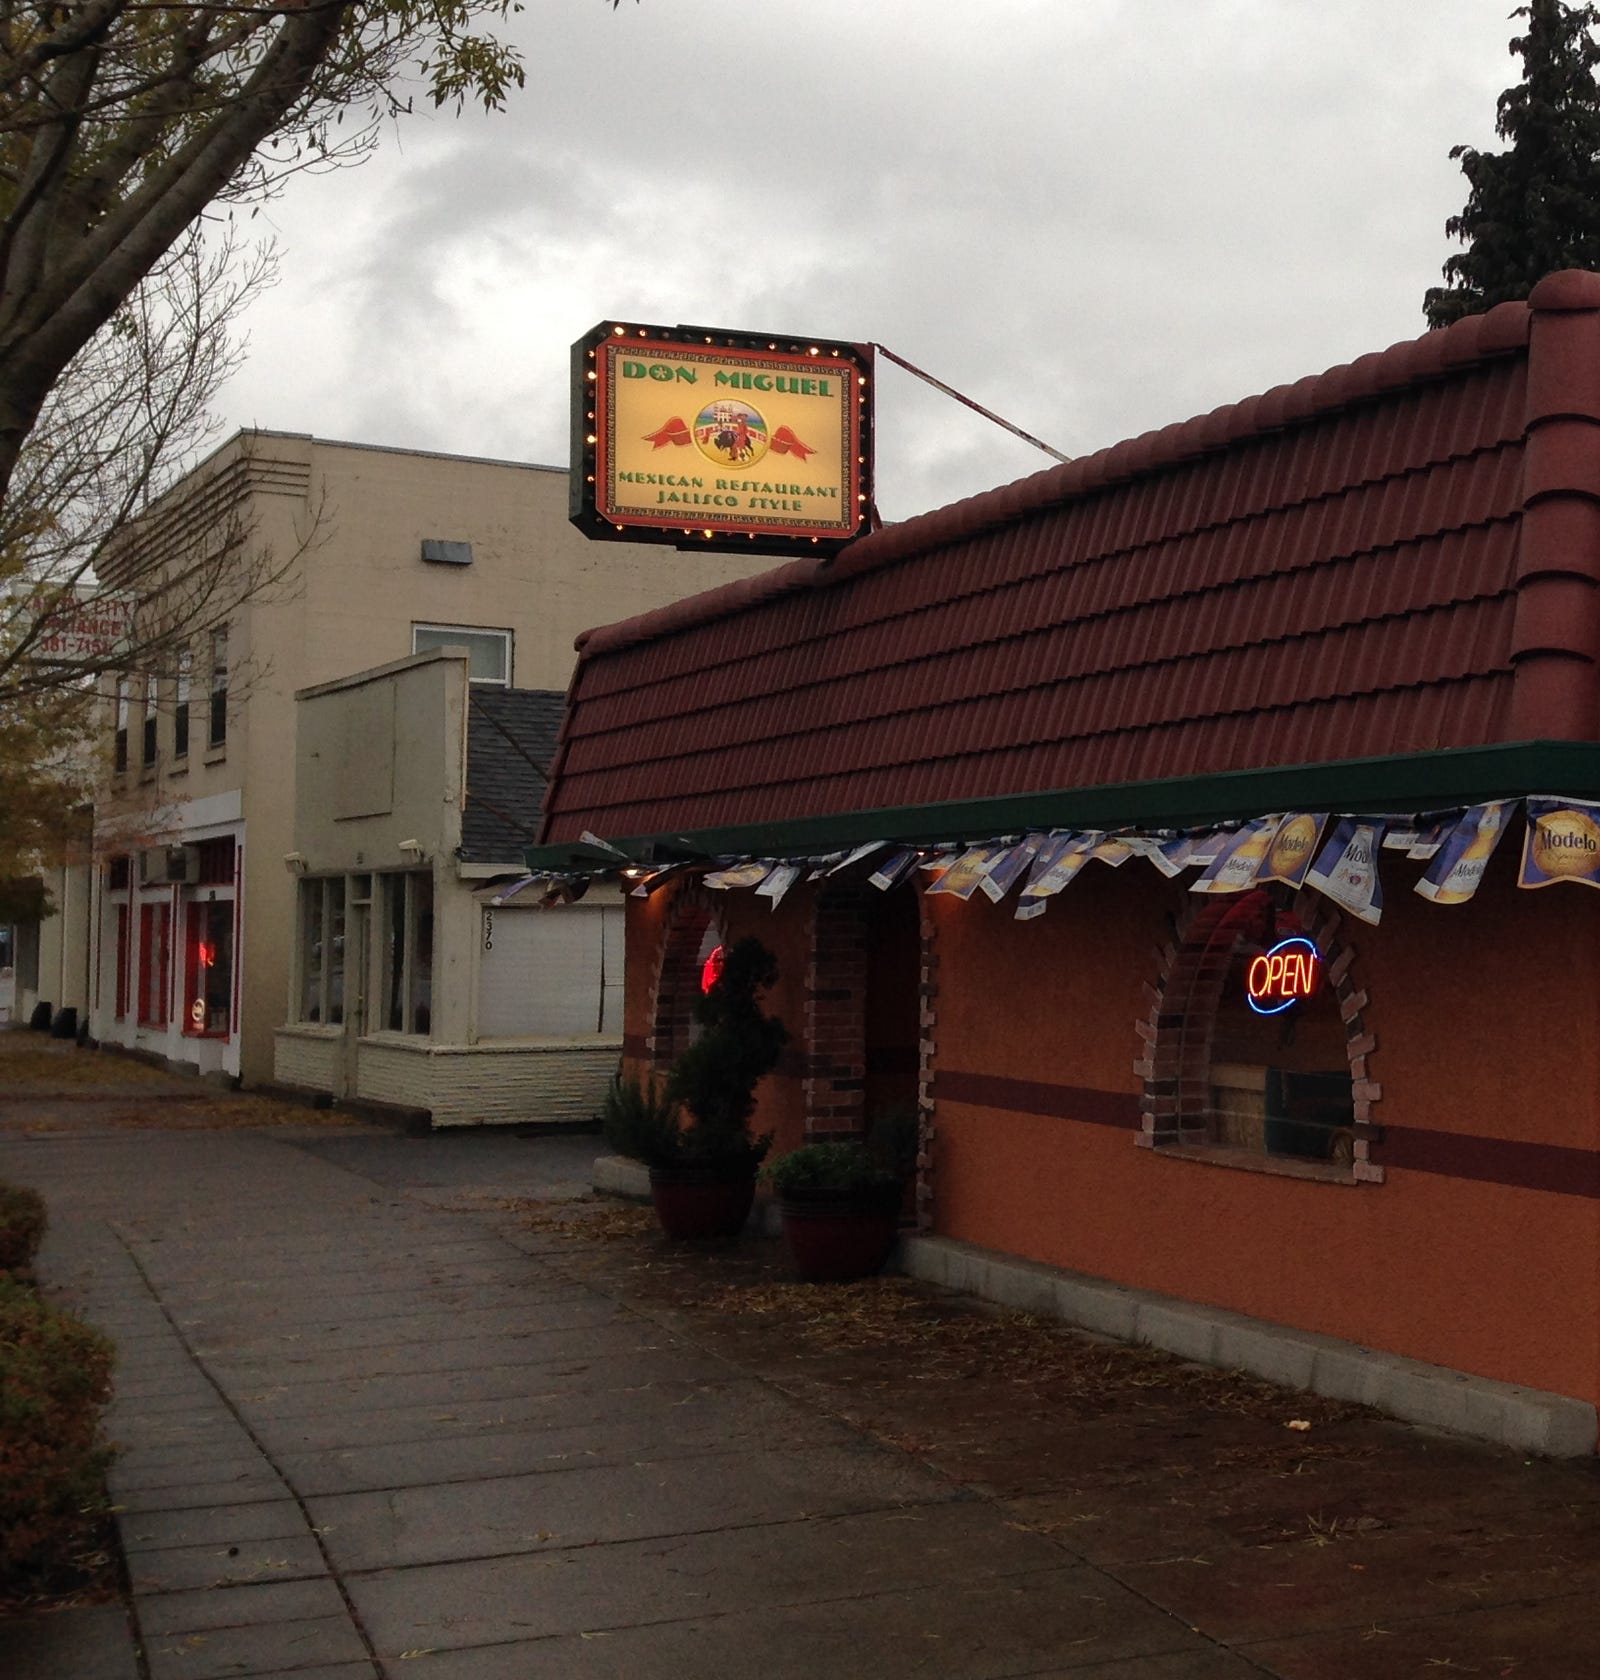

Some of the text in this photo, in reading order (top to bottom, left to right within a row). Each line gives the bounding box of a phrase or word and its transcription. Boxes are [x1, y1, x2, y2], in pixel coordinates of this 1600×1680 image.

[623, 361, 834, 397] DON MIGUEL
[618, 471, 838, 498] MEXICAN RESTAURANT
[656, 491, 803, 511] JALISCO STYLE
[1542, 829, 1596, 853] Modelo
[1249, 954, 1314, 996] OPEN
